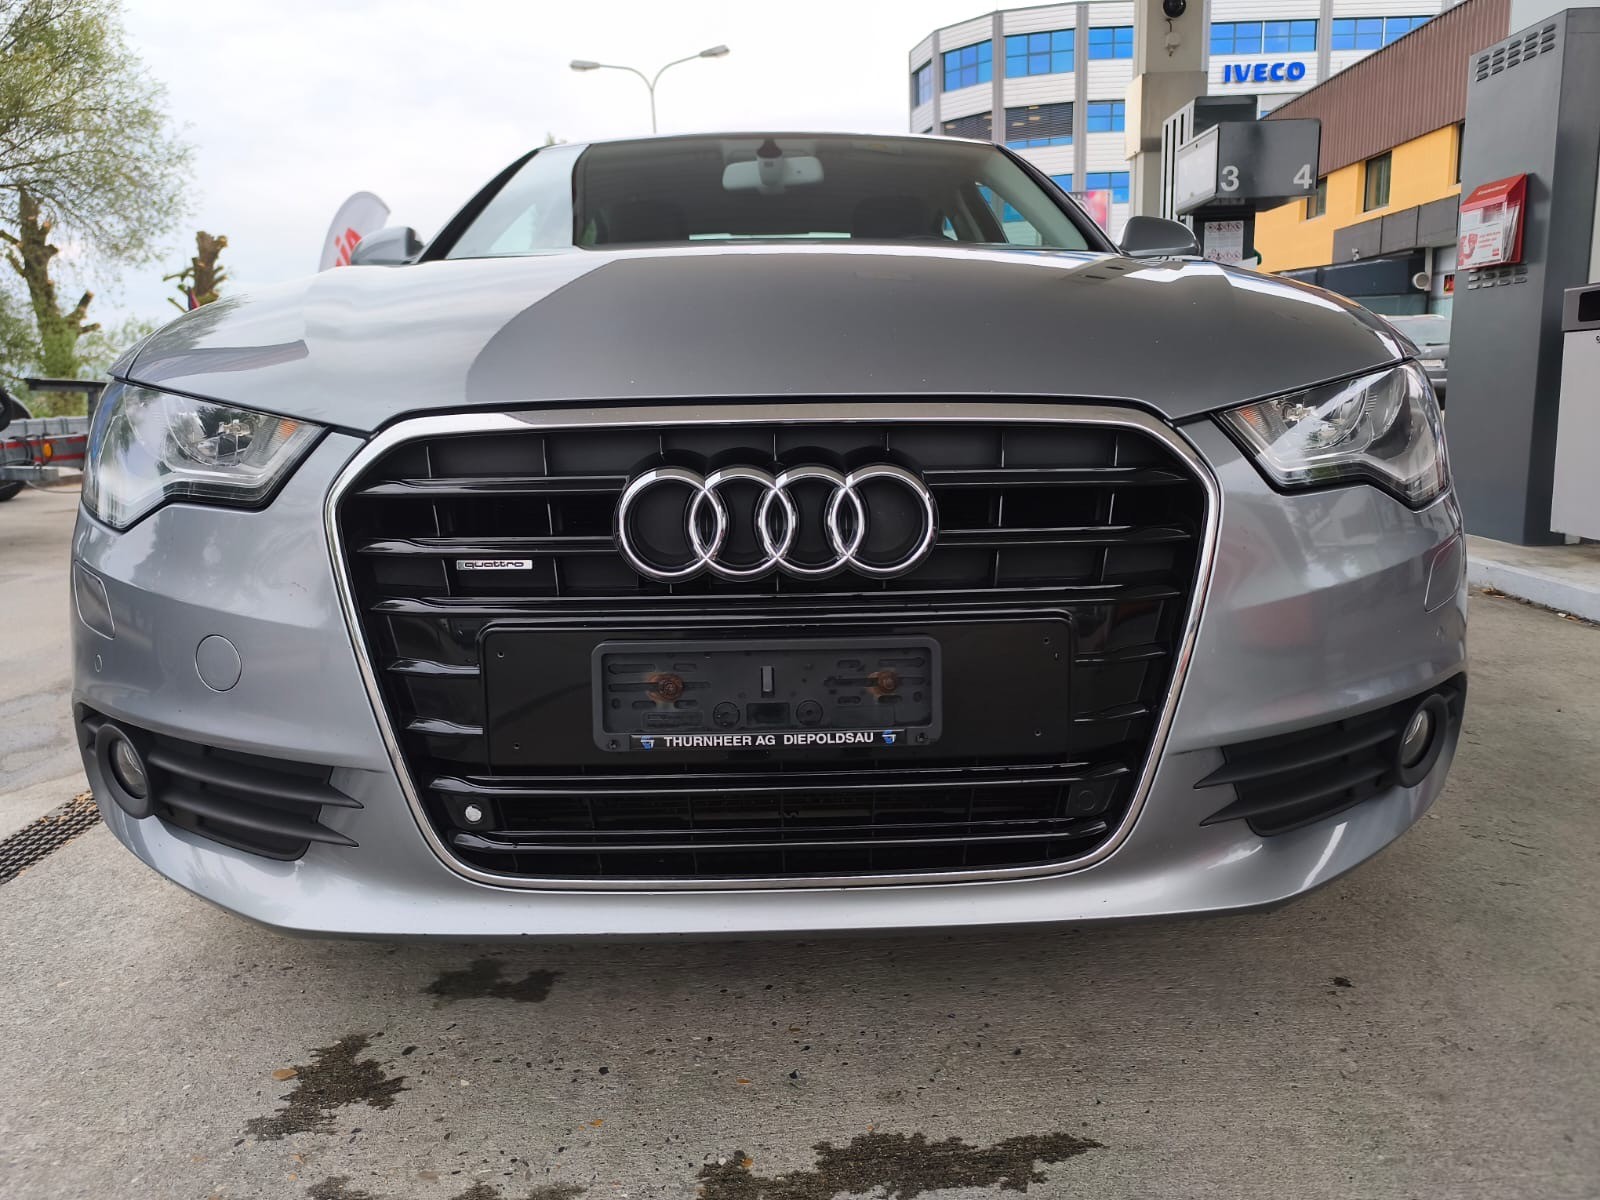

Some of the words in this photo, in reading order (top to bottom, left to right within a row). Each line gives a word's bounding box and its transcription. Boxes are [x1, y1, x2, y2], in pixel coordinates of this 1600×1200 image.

[1224, 62, 1306, 83] IVECO
[1221, 165, 1240, 192] 3
[1293, 164, 1313, 190] 4
[464, 561, 524, 569] quattro
[664, 735, 751, 748] THURNHEER
[755, 735, 776, 746] AG
[783, 732, 874, 745] DIEPOLDSAU
